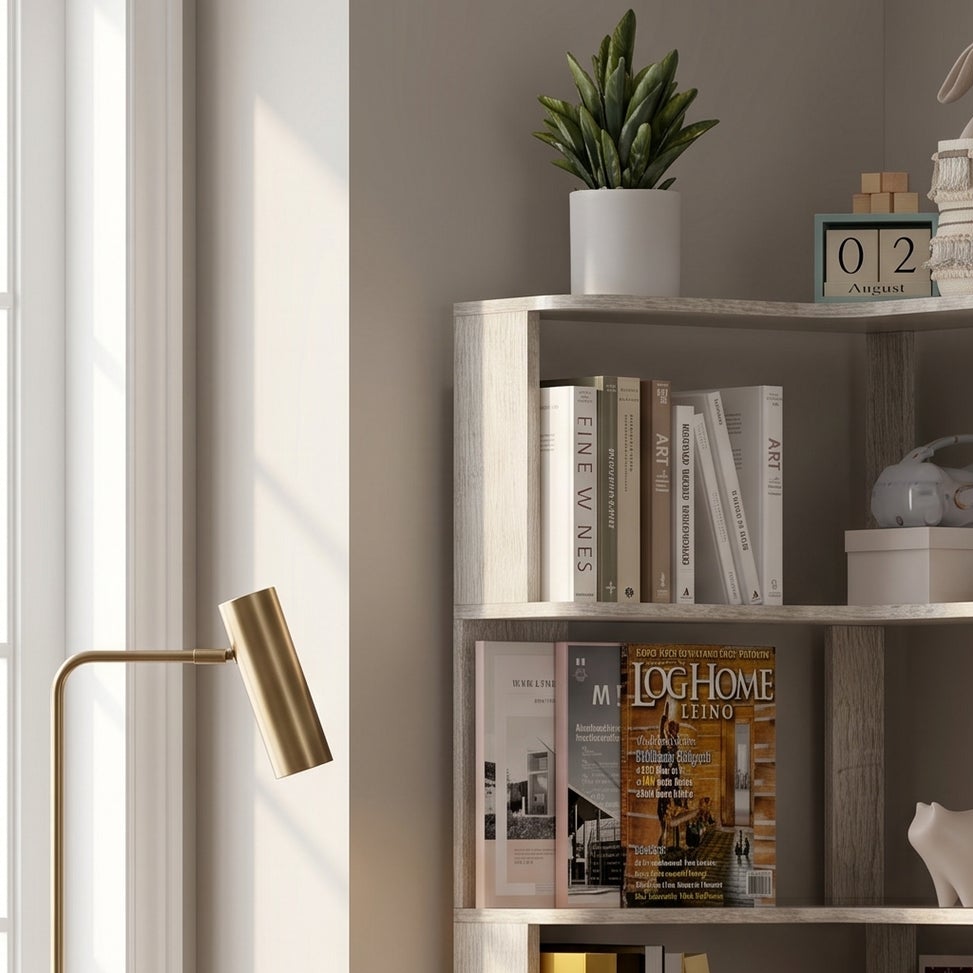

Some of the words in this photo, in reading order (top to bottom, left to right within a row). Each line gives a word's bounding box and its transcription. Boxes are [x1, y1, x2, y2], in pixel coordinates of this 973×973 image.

[848, 282, 905, 296] August
[655, 432, 670, 467] ART
[768, 437, 781, 471] ART
[681, 703, 734, 721] LEINO
